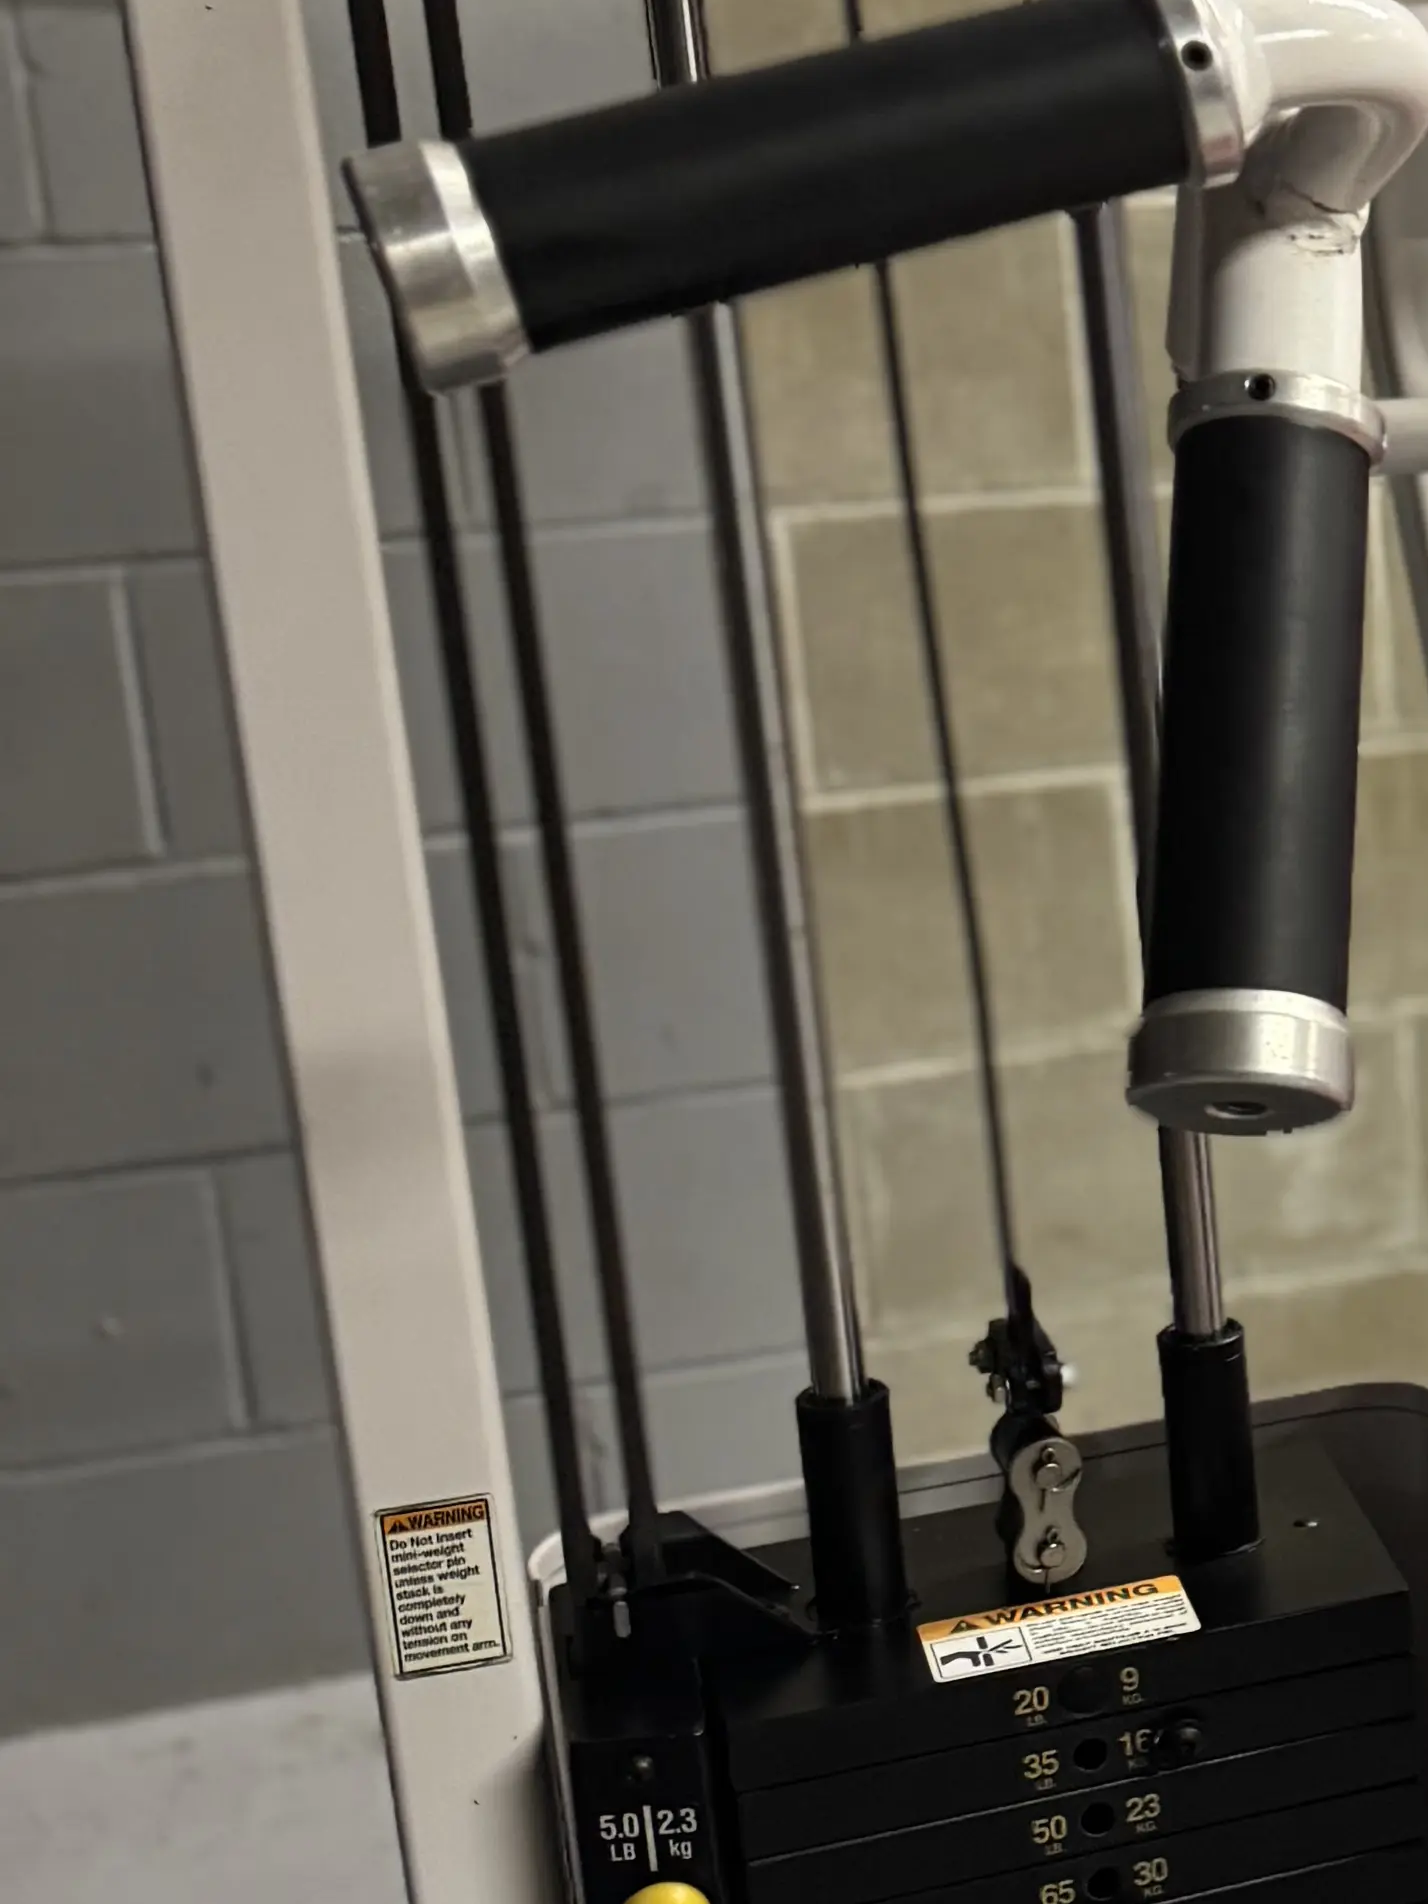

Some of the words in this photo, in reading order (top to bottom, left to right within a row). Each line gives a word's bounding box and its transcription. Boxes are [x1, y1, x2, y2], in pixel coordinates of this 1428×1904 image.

[409, 1504, 485, 1529] WARNING
[390, 1539, 407, 1551] Do
[411, 1533, 434, 1547] Not
[392, 1542, 465, 1563] mini-weight
[393, 1560, 443, 1576] selector
[447, 1556, 466, 1570] pin
[395, 1574, 434, 1589] unless
[439, 1565, 480, 1582] weight
[396, 1586, 430, 1601] stack
[433, 1584, 444, 1595] is
[398, 1594, 466, 1613] completely
[400, 1612, 434, 1625] down
[436, 1606, 460, 1620] and
[985, 1583, 1159, 1626] WARNING
[401, 1622, 447, 1637] without
[450, 1618, 472, 1632] any
[402, 1635, 448, 1650] tension
[451, 1631, 468, 1642] on
[404, 1643, 470, 1662] movement
[472, 1639, 499, 1652] arm.
[1013, 1686, 1050, 1716] 20
[1119, 1667, 1139, 1691] 9
[1023, 1749, 1060, 1779] 35
[599, 1813, 640, 1840] 5.0
[657, 1808, 698, 1835] 2.3
[1031, 1815, 1067, 1844] 50
[1126, 1794, 1161, 1822] 23
[610, 1843, 636, 1862] LB
[669, 1839, 692, 1860] kg
[1132, 1857, 1168, 1886] 30
